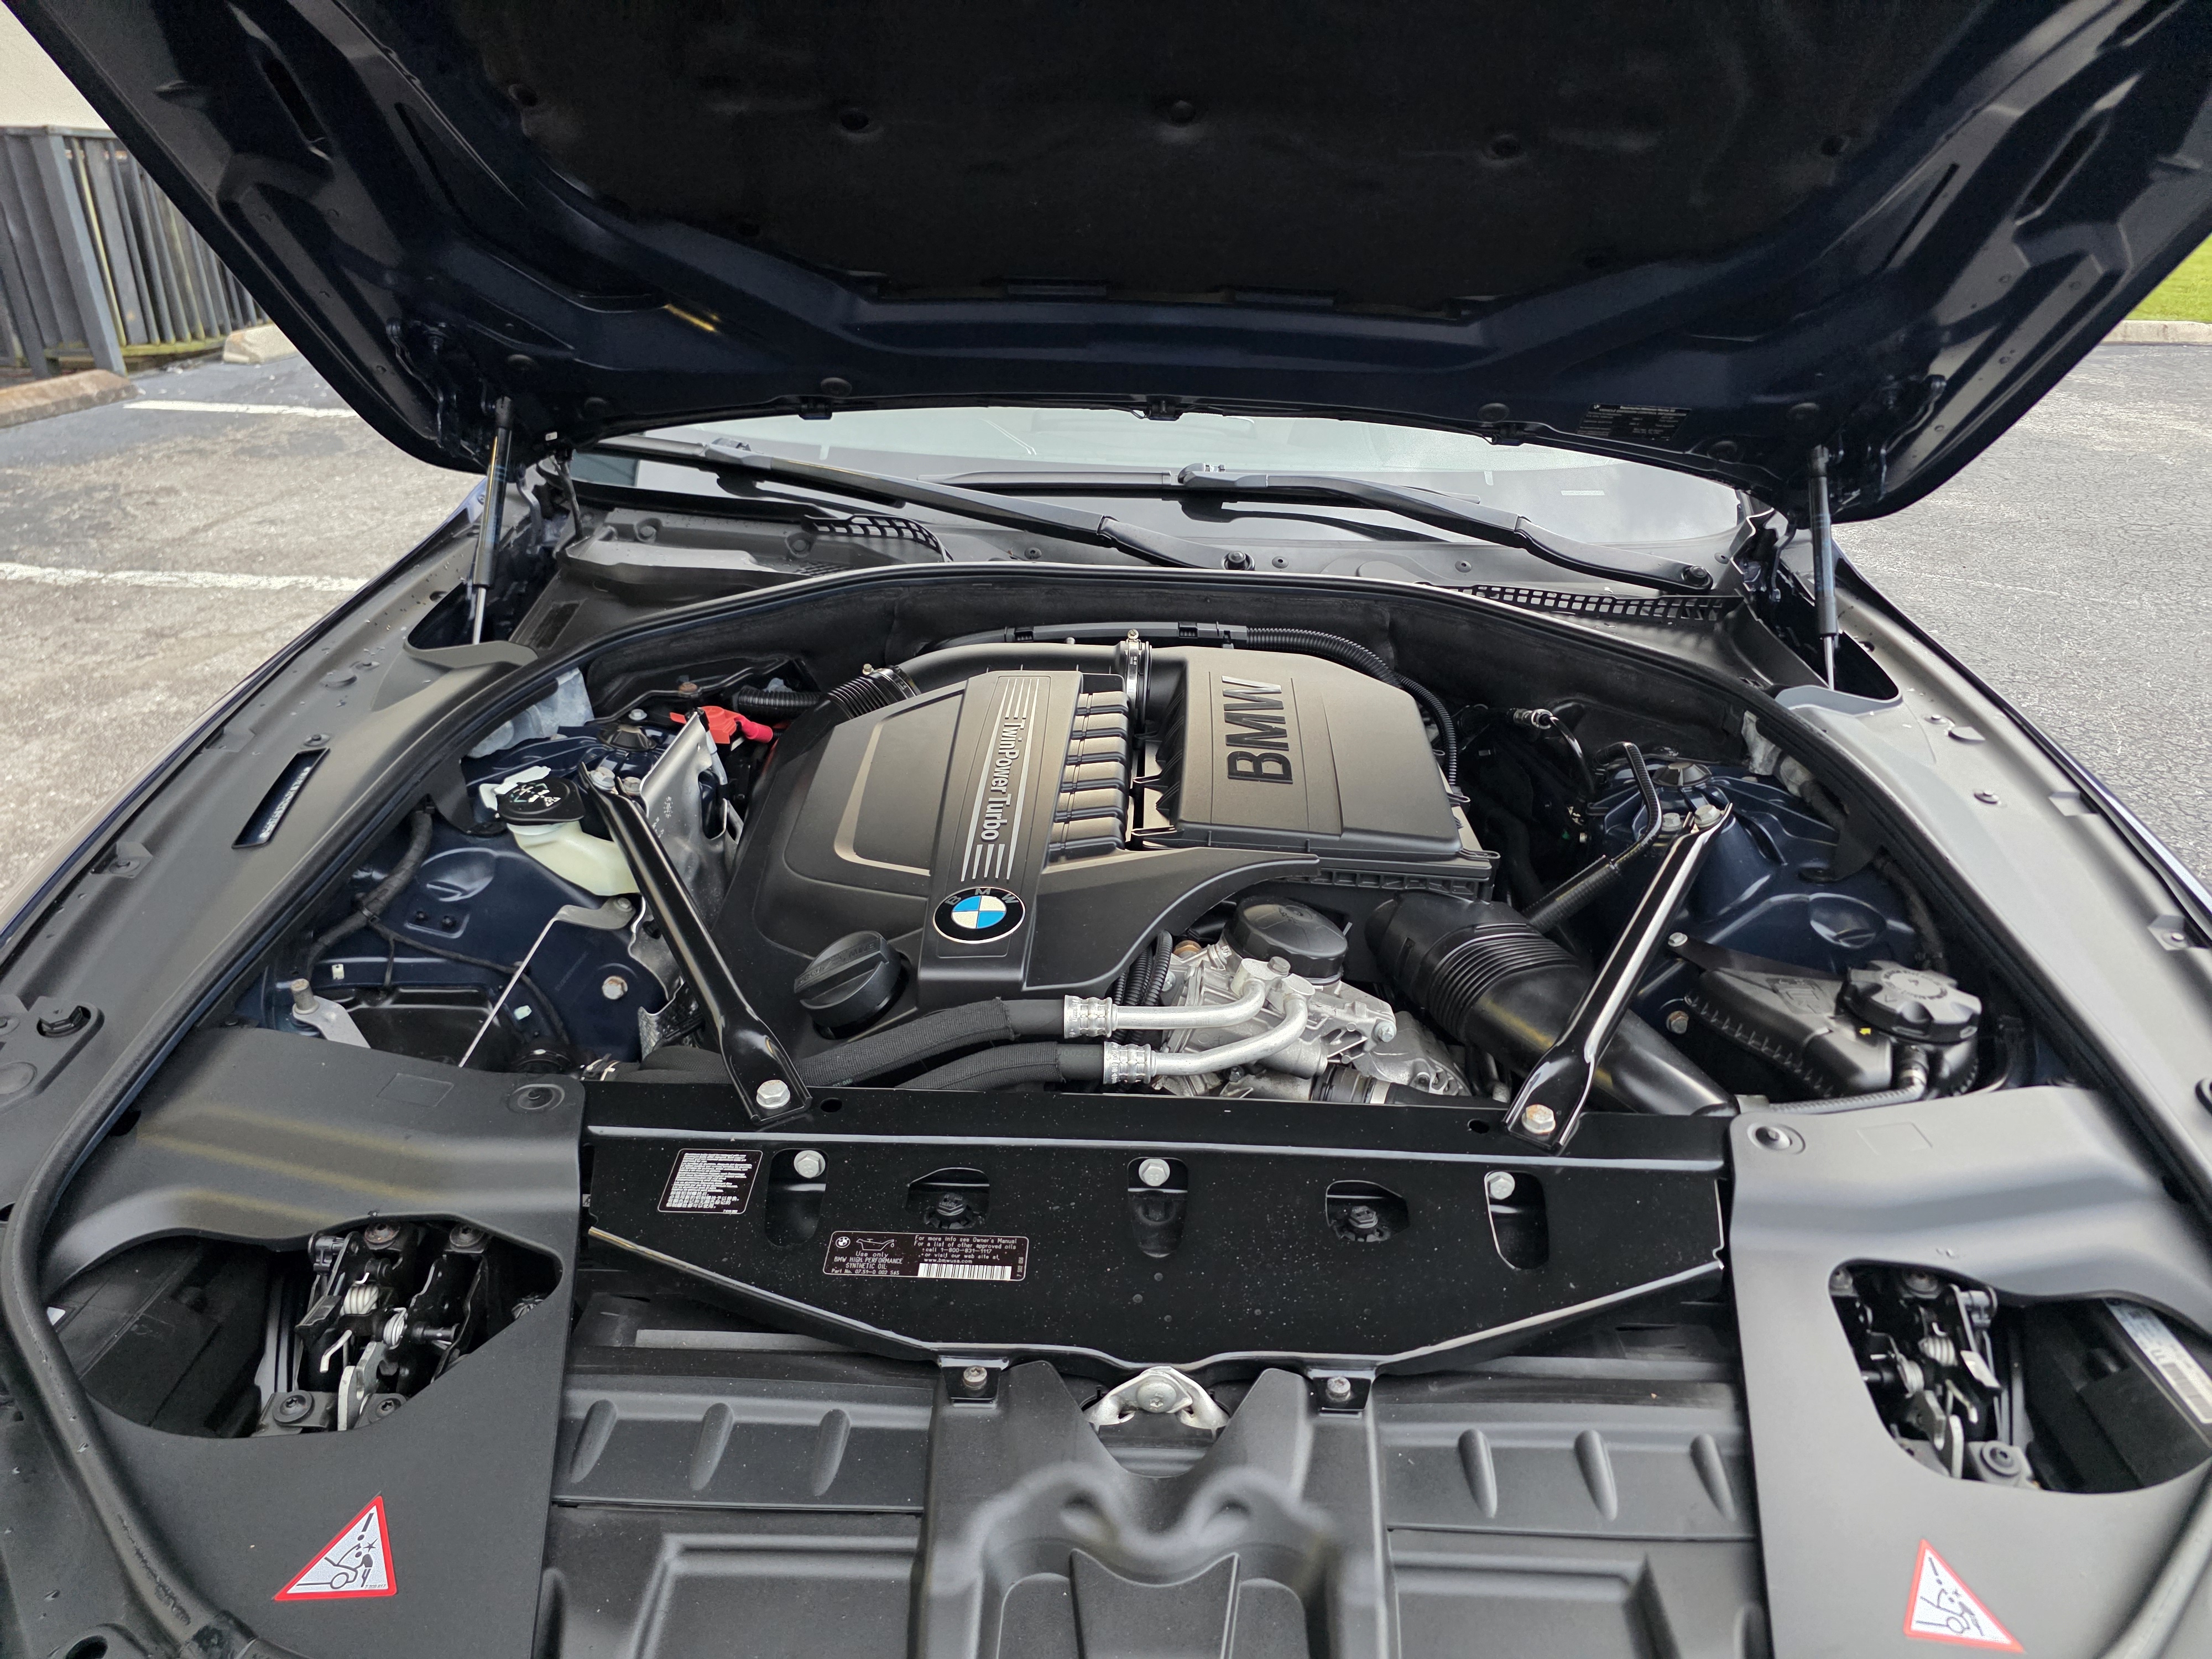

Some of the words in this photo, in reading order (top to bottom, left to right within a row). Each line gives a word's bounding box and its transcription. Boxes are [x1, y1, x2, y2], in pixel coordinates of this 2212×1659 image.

[990, 719, 1026, 794] TwinPower
[1222, 676, 1293, 784] BMW
[981, 794, 1012, 842] Turbo
[945, 888, 1019, 906] BMW
